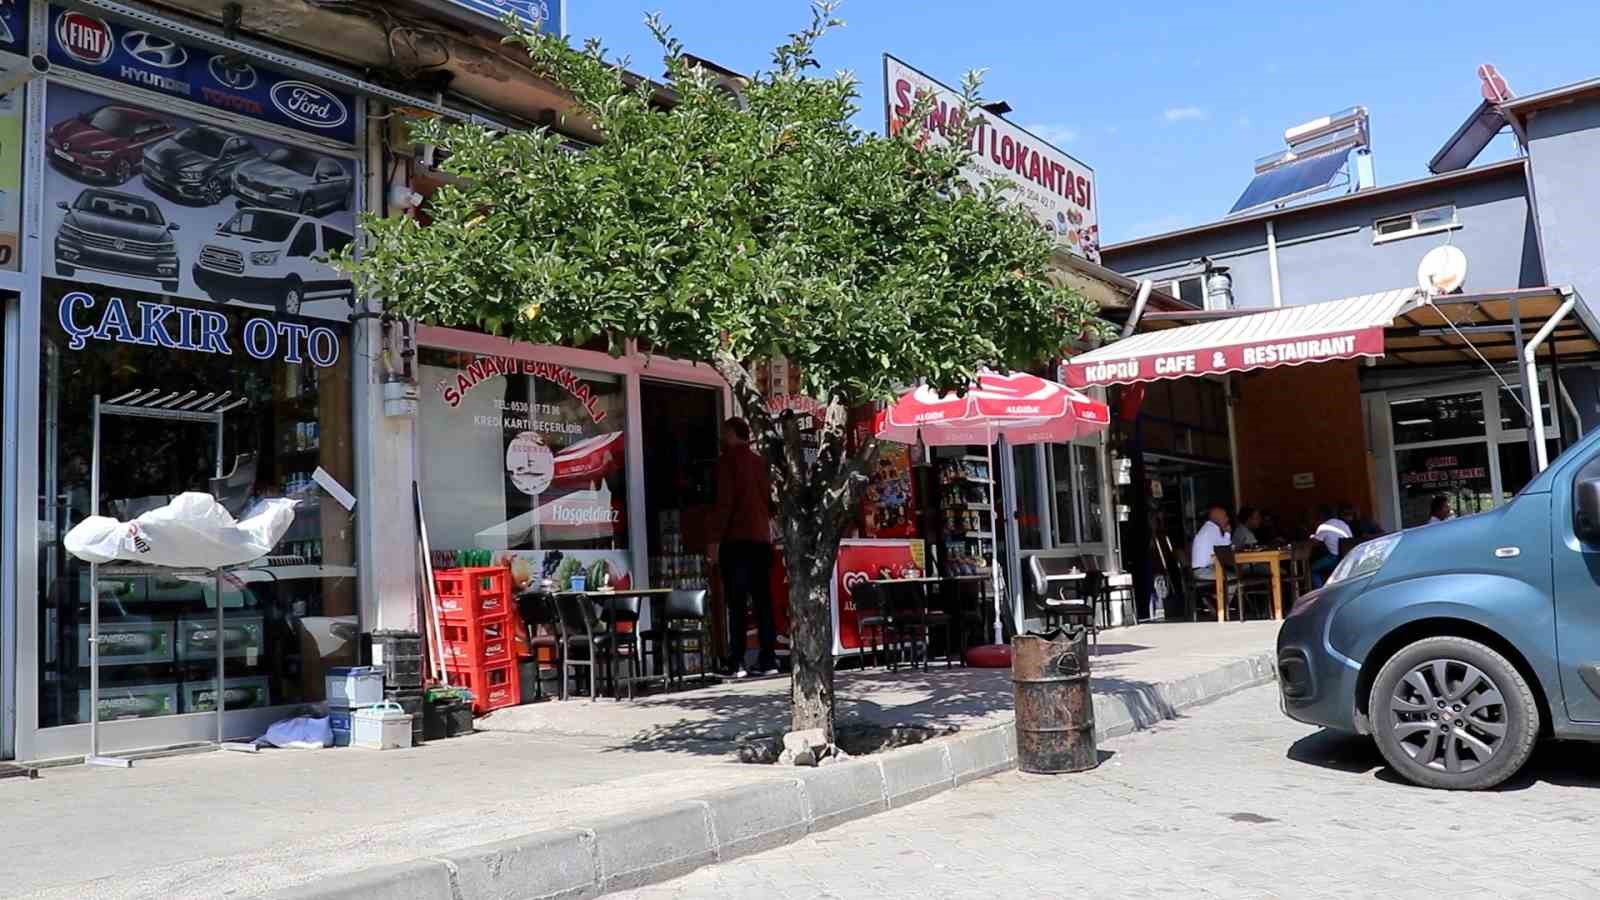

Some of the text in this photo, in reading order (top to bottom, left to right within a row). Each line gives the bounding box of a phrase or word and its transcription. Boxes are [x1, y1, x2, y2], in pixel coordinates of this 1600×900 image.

[69, 22, 103, 53] FIAT
[287, 87, 330, 119] Ford
[990, 128, 1092, 211] LOKANTASI
[58, 291, 340, 368] ÇAKIR OTO
[1154, 354, 1196, 375] CAFE
[1211, 350, 1227, 368] &
[1242, 335, 1356, 365] RESTAURANT
[523, 358, 608, 425] BAKKALI
